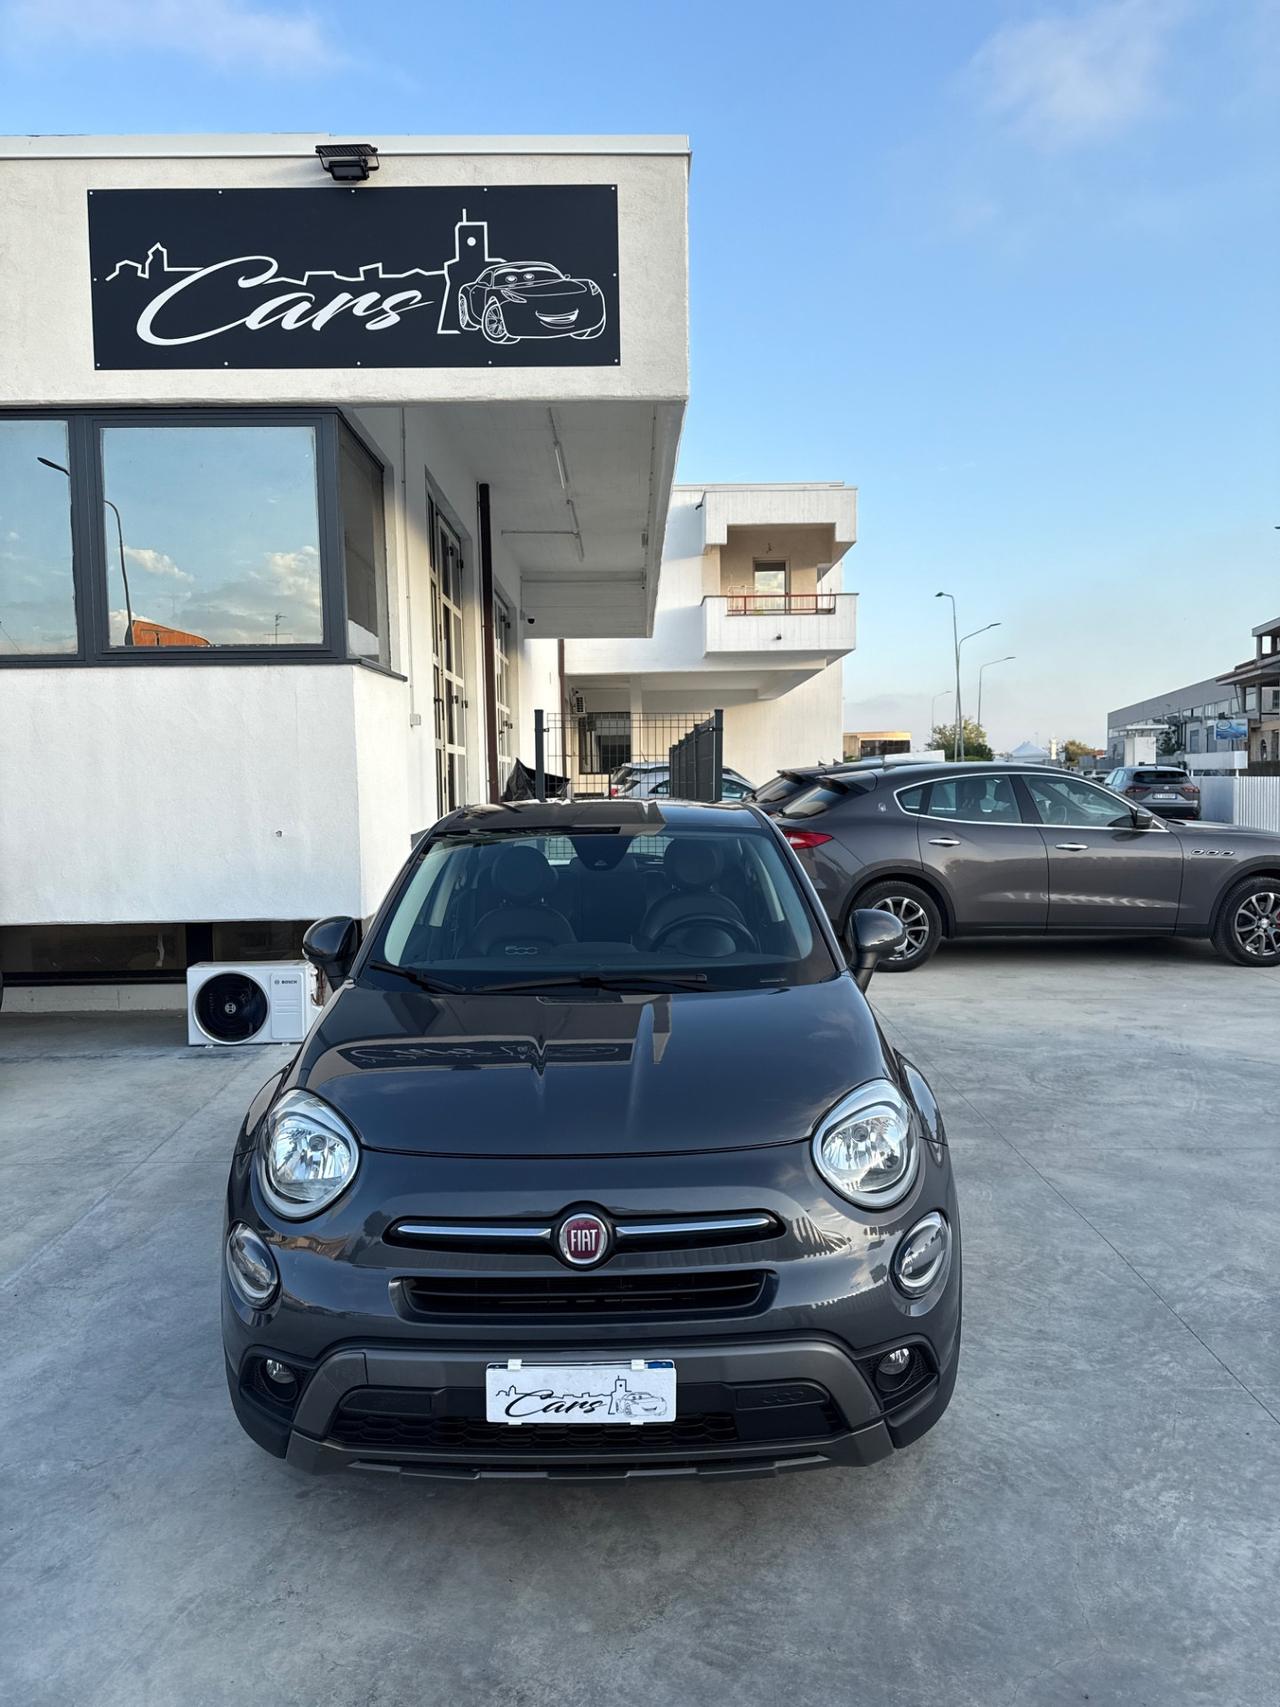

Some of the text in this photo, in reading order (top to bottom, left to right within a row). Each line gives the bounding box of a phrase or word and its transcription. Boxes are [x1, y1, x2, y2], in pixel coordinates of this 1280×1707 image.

[136, 256, 434, 346] Cars
[570, 1229, 598, 1251] FIAT
[505, 1389, 607, 1417] Cars
